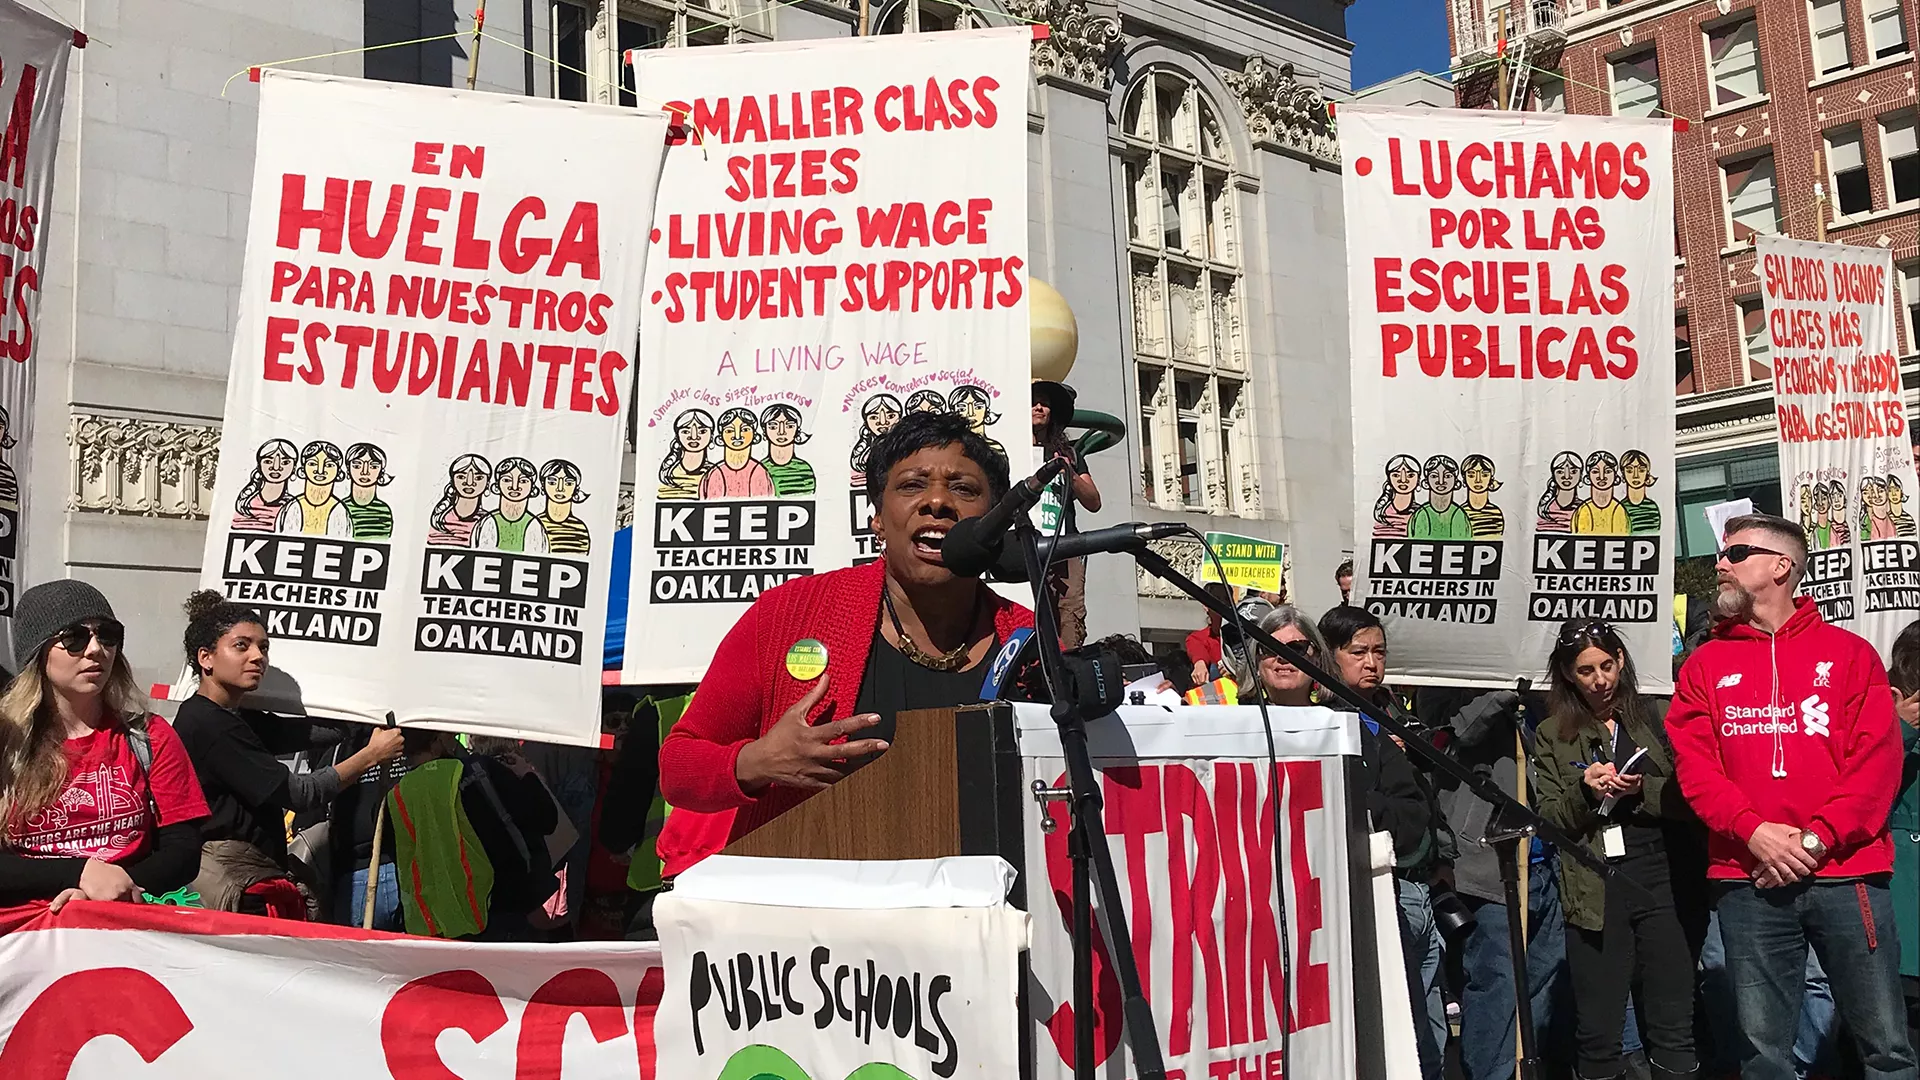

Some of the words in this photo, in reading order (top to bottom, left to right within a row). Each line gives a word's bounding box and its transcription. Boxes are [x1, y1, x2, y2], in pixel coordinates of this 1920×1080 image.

[874, 75, 1000, 132] CLASS
[412, 142, 485, 179] EN
[725, 148, 860, 201] SIZES
[1388, 138, 1650, 200] LUCHAMOS
[276, 173, 600, 280] HUELGA
[668, 208, 843, 259] LIVING
[857, 198, 992, 248] WAGE
[1429, 207, 1513, 249] POR
[1522, 206, 1606, 250] LAS
[270, 261, 375, 313] PARA
[386, 275, 615, 336] NUESTROS
[665, 266, 837, 323] STUDENT
[840, 255, 1023, 313] SUPPORTS
[1373, 257, 1630, 315] ESCUELAS
[1764, 253, 1828, 302] SALARIOS
[1833, 262, 1884, 307] DIGNOS
[1770, 308, 1825, 350] CLASES
[263, 316, 628, 416] ESTUDIANTES
[717, 348, 738, 376] A
[755, 344, 845, 374] LIVING
[860, 342, 928, 367] WAGE
[1380, 324, 1639, 381] PUBLICAS
[1778, 404, 1811, 443] PARA
[659, 505, 810, 544] KEEP
[228, 538, 383, 583] KEEP
[656, 548, 777, 567] TEACHERS
[785, 548, 809, 565] IN
[1225, 543, 1253, 558] STAND
[1254, 544, 1277, 559] WITH
[1372, 543, 1498, 576] KEEP
[1537, 538, 1656, 571] KEEP
[426, 553, 582, 600] KEEP
[1240, 566, 1276, 579] TEACHERS
[1370, 580, 1469, 596] TEACHERS
[1475, 581, 1495, 596] IN
[1534, 575, 1631, 592] TEACHERS
[1637, 576, 1655, 591] IN
[224, 580, 346, 606] TEACHERS
[354, 590, 378, 609] IN
[423, 597, 547, 622] TEACHERS
[554, 607, 578, 627] IN
[1533, 597, 1654, 620] OAKLAND
[420, 622, 577, 660] OAKLAND
[1813, 679, 1831, 688] LFC
[1721, 719, 1798, 737] Chartered
[1725, 702, 1796, 720] Standard
[56, 836, 109, 850] OAKLAND
[64, 827, 87, 840] ARE
[90, 821, 111, 835] THE
[113, 813, 145, 832] HEART
[1044, 761, 1331, 1072] STRIKE
[690, 950, 804, 1056] PUBLIC
[809, 945, 958, 1079] SCHOOLS
